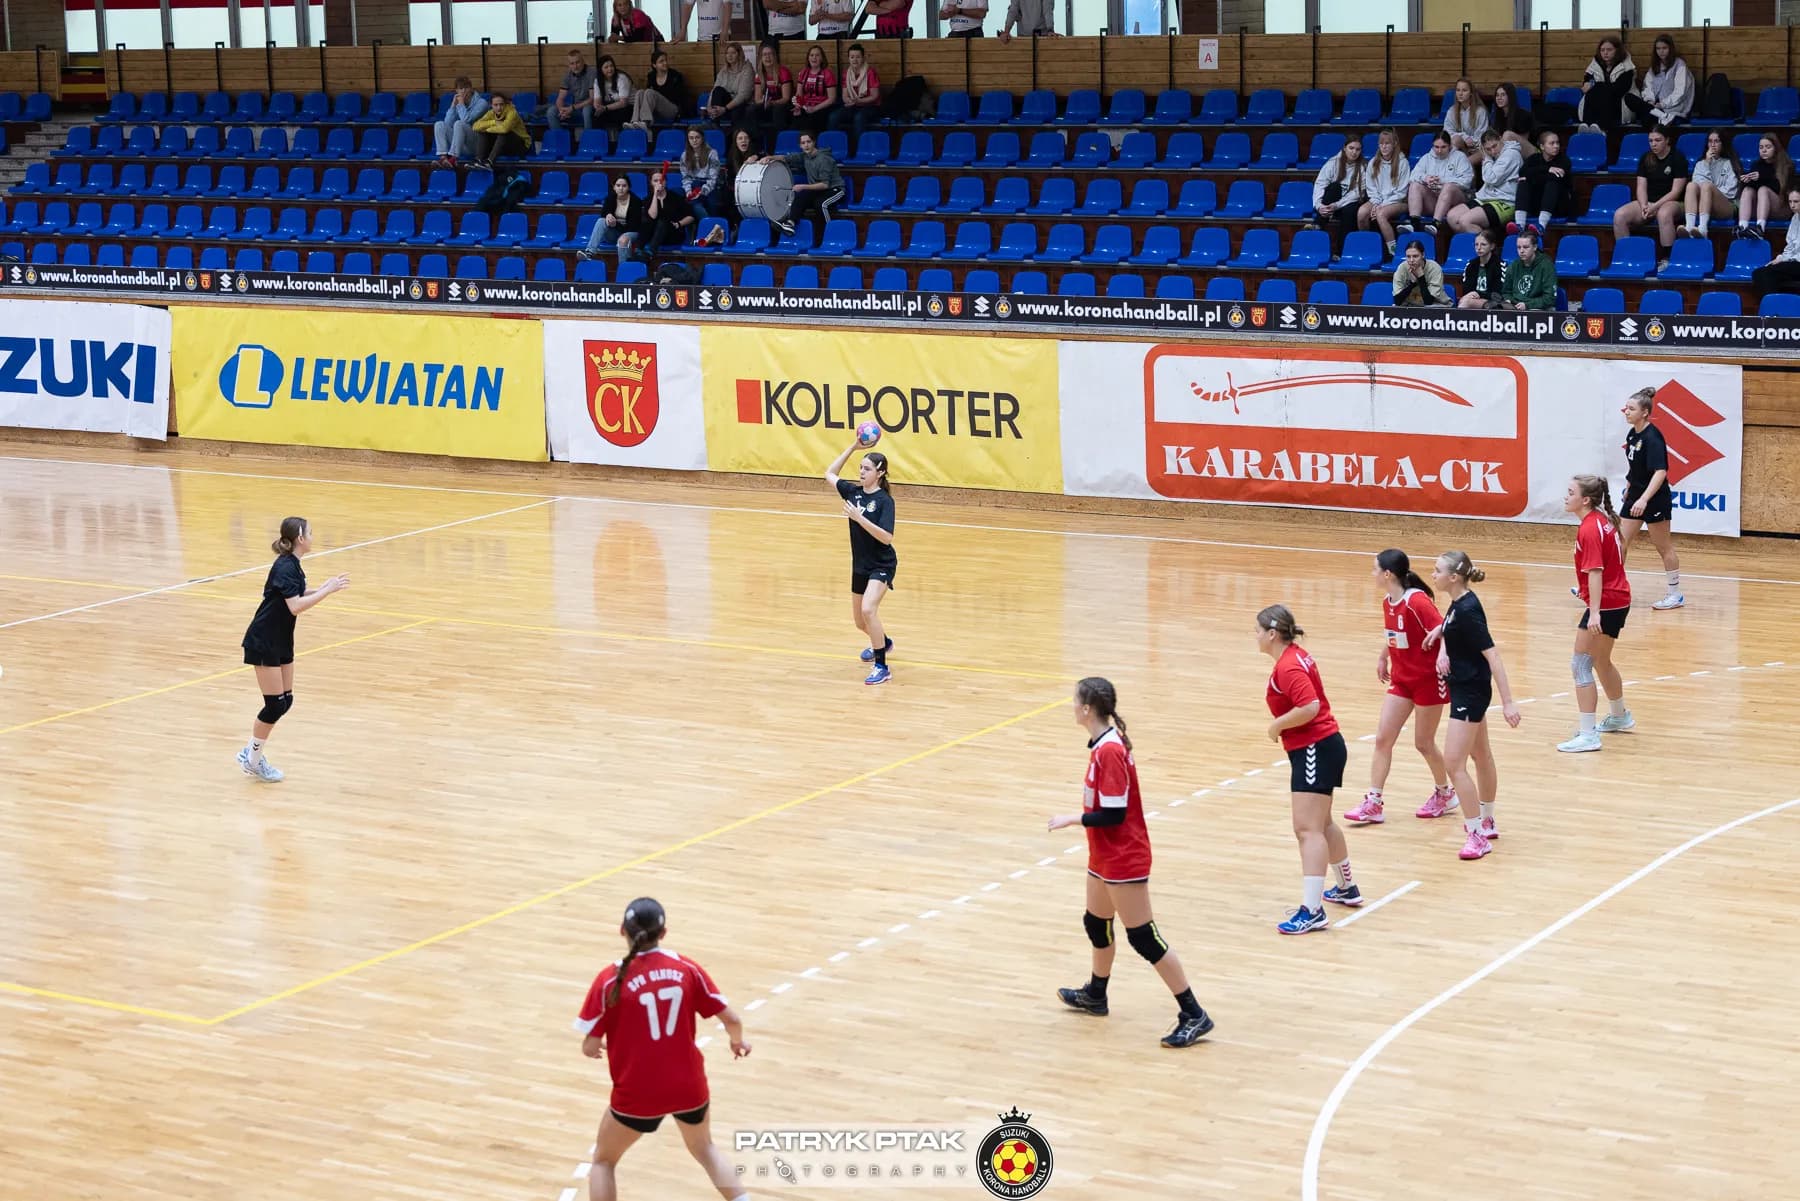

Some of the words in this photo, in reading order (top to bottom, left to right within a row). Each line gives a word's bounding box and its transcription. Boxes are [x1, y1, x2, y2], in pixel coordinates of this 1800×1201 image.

[1204, 52, 1212, 63] A
[40, 269, 181, 291] www.koronahandball.pl
[252, 275, 405, 298] www.koronahandball.pl
[484, 285, 651, 309] www.koronahandball.pl
[737, 292, 922, 316] www.koronahandball.pl
[1017, 300, 1221, 327] www.koronahandball.pl
[1327, 311, 1554, 340] www.koronahandball.pl
[291, 353, 504, 411] LEWIATAN
[595, 383, 646, 435] CK
[764, 380, 1023, 439] KOLPORTER
[1162, 445, 1509, 494] KARABELA-CK
[639, 985, 684, 1041] 17
